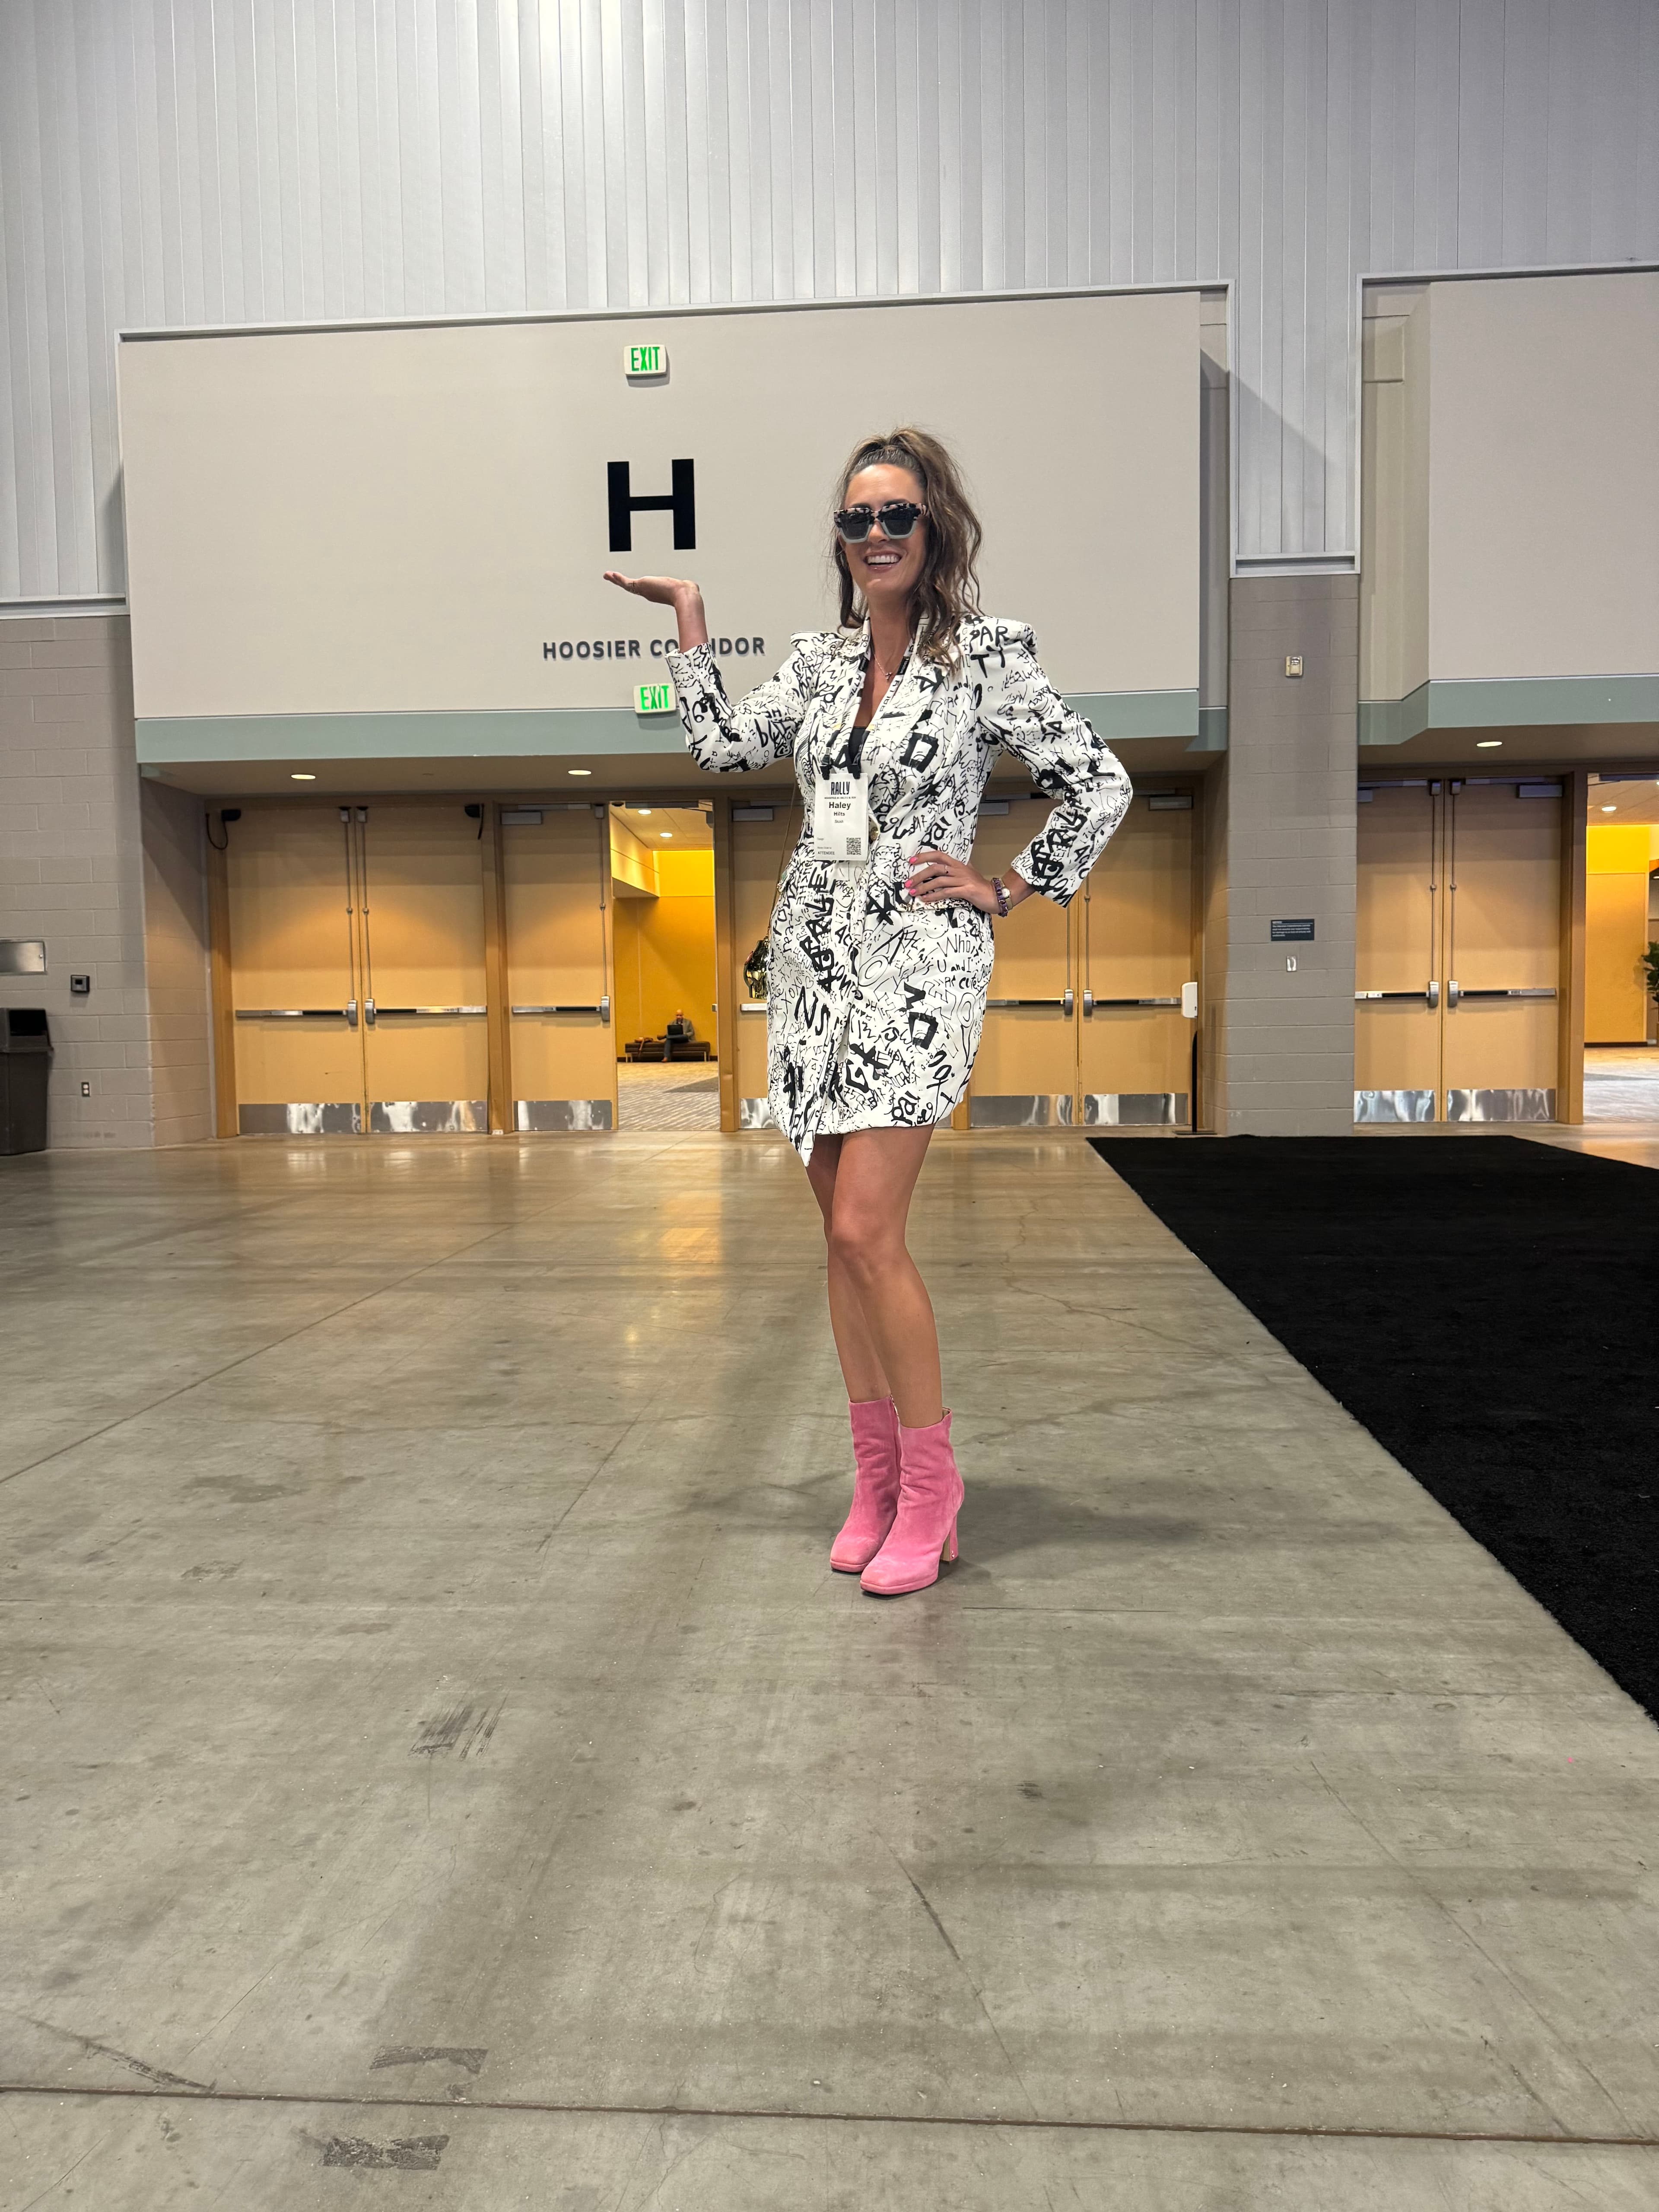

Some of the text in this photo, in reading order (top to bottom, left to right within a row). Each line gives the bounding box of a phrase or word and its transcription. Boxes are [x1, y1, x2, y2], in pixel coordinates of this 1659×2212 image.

[631, 347, 660, 371] EXIT
[607, 459, 696, 552] H
[543, 637, 764, 659] HOOSIER COIDOR
[640, 685, 668, 709] EXIT
[831, 782, 850, 795] RALLY
[829, 802, 851, 810] Haley
